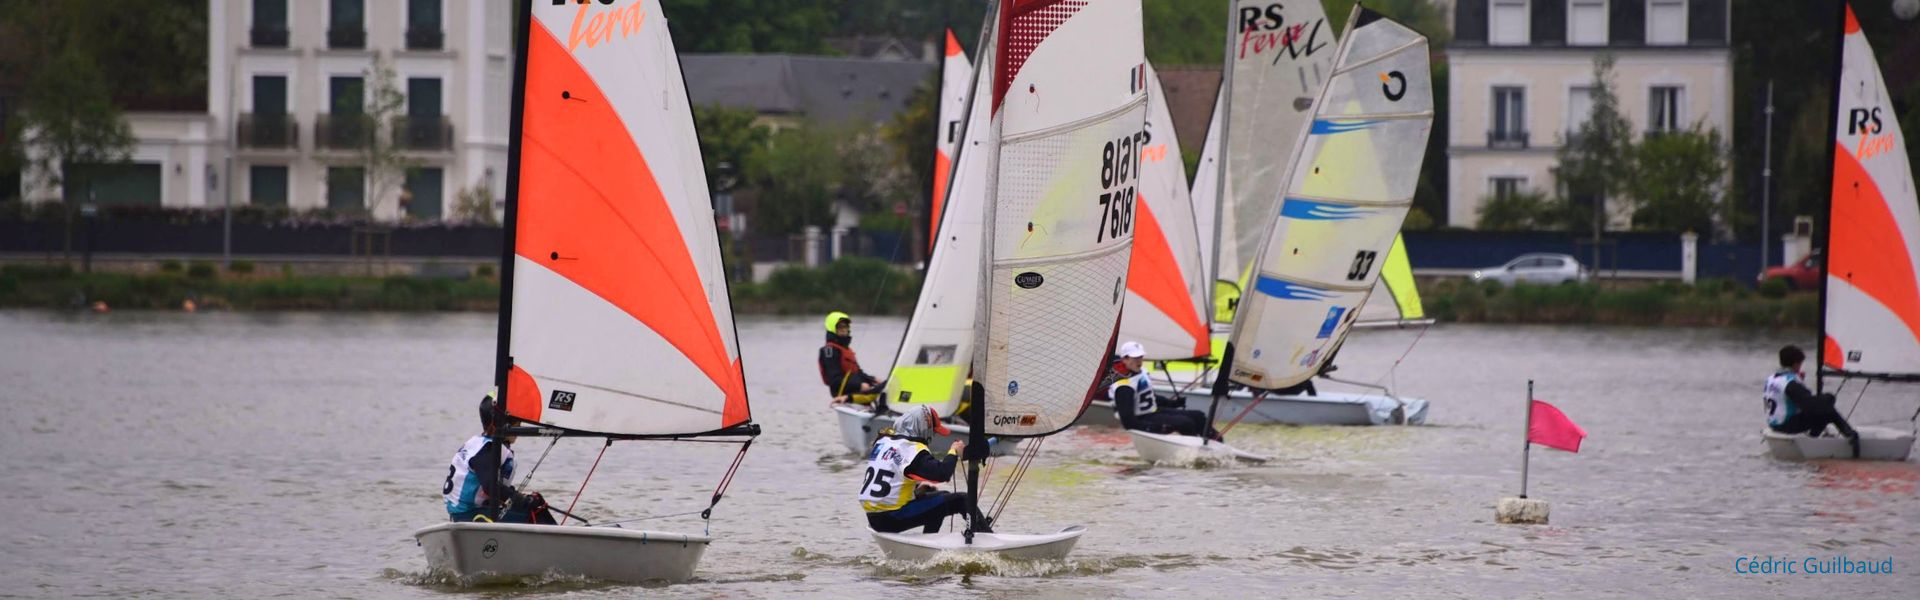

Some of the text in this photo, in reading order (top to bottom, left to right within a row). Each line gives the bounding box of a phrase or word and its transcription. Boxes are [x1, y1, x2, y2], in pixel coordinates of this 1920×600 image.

[1239, 4, 1283, 33] RS
[1272, 18, 1327, 66] XL
[1849, 106, 1882, 135] RS
[1097, 186, 1134, 244] 7618
[1346, 250, 1377, 281] 33
[554, 391, 574, 404] RS
